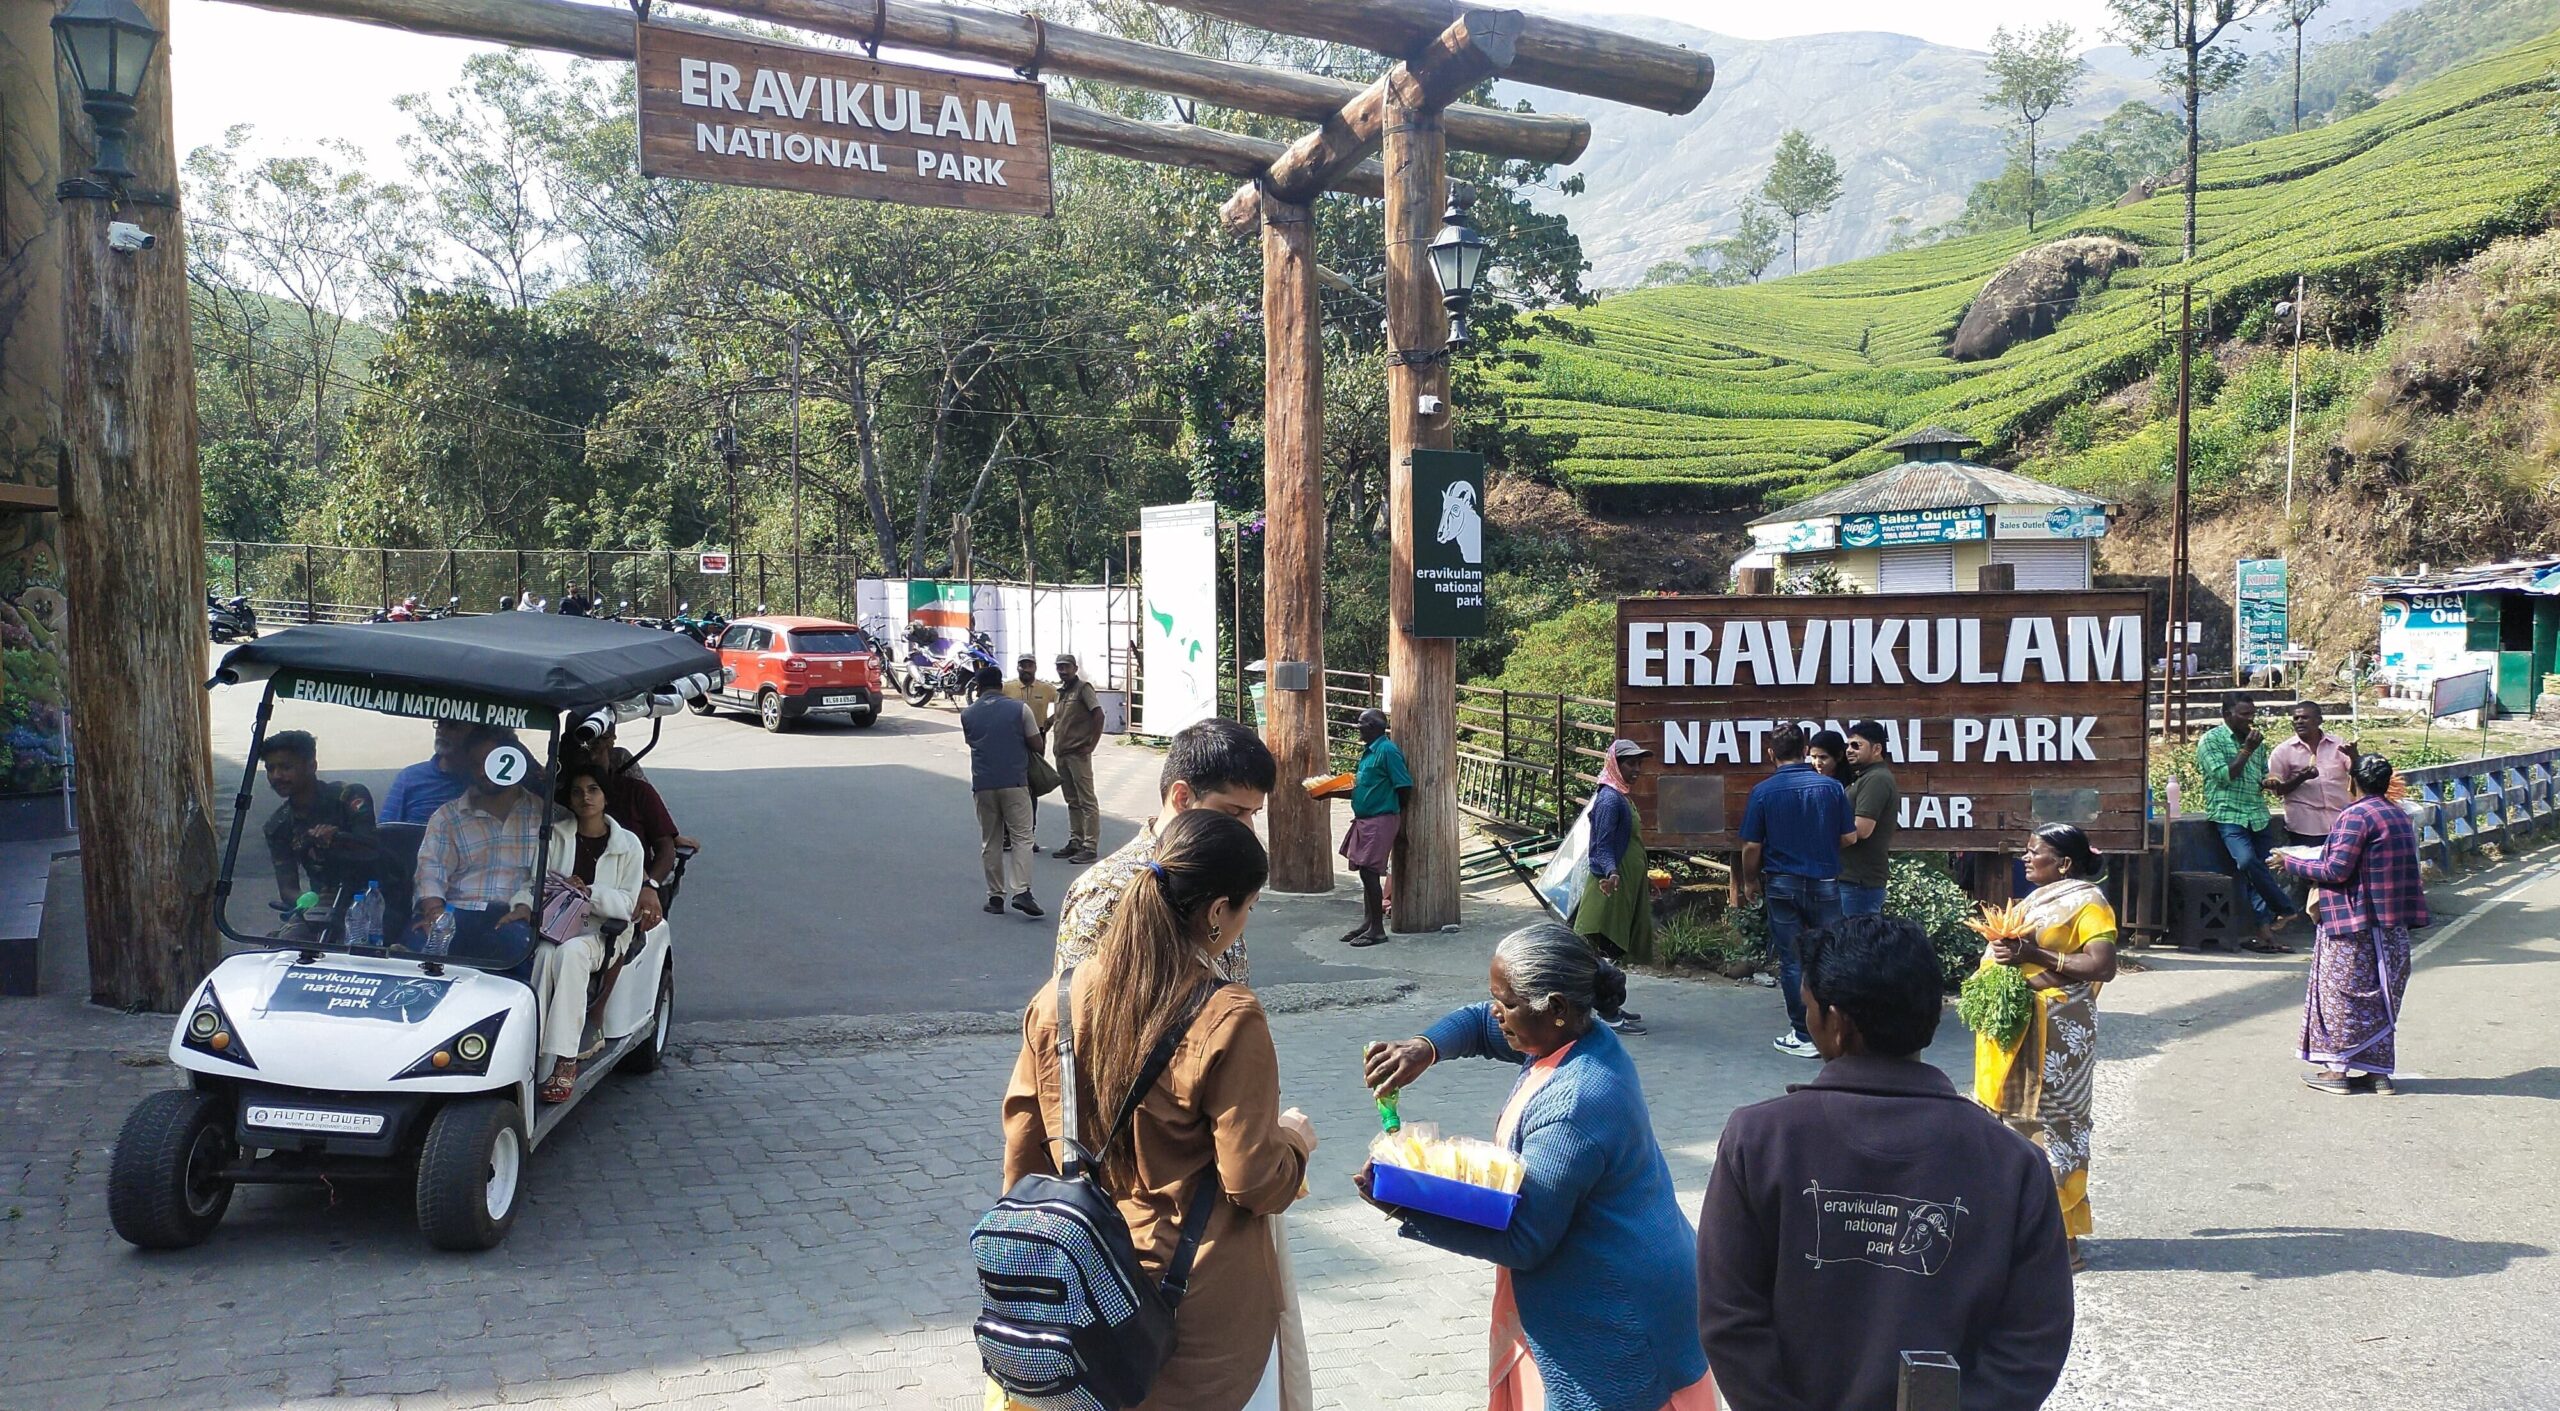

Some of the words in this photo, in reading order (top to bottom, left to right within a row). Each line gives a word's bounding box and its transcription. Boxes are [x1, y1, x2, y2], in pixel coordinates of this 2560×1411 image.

[680, 57, 1018, 146] ERAVIKULAM
[697, 123, 888, 173] NATIONAL
[917, 150, 1008, 186] PARK
[1878, 513, 1918, 525] Sales
[1921, 508, 1968, 521] Outlet
[2045, 511, 2070, 524] Ripple
[1843, 520, 1875, 534] Ripple
[1881, 524, 1916, 533] FACTORY
[2022, 521, 2046, 529] Outlet
[1920, 529, 1941, 537] HERE
[1416, 568, 1482, 580] eravikulam
[1435, 581, 1482, 593] national
[1456, 595, 1482, 609] park
[2411, 594, 2464, 609] Sales
[2430, 609, 2467, 624] Out
[2250, 632, 2270, 640] Ginger
[1628, 615, 2143, 687] ERAVIKULAM
[293, 679, 399, 712] ERAVIKULAM
[401, 693, 482, 723] NATIONAL
[485, 704, 529, 729] PARK
[1664, 718, 1940, 764] NATAL
[1953, 716, 2099, 763] PARK
[496, 754, 516, 781] 2
[287, 971, 382, 986] eravikulam
[302, 982, 378, 997] national
[327, 997, 372, 1010] park
[273, 1110, 315, 1121] AUTO
[320, 1114, 371, 1125] POWER
[1824, 1199, 1898, 1217] eravikulam
[1844, 1218, 1897, 1236] national
[1866, 1240, 1894, 1256] park
